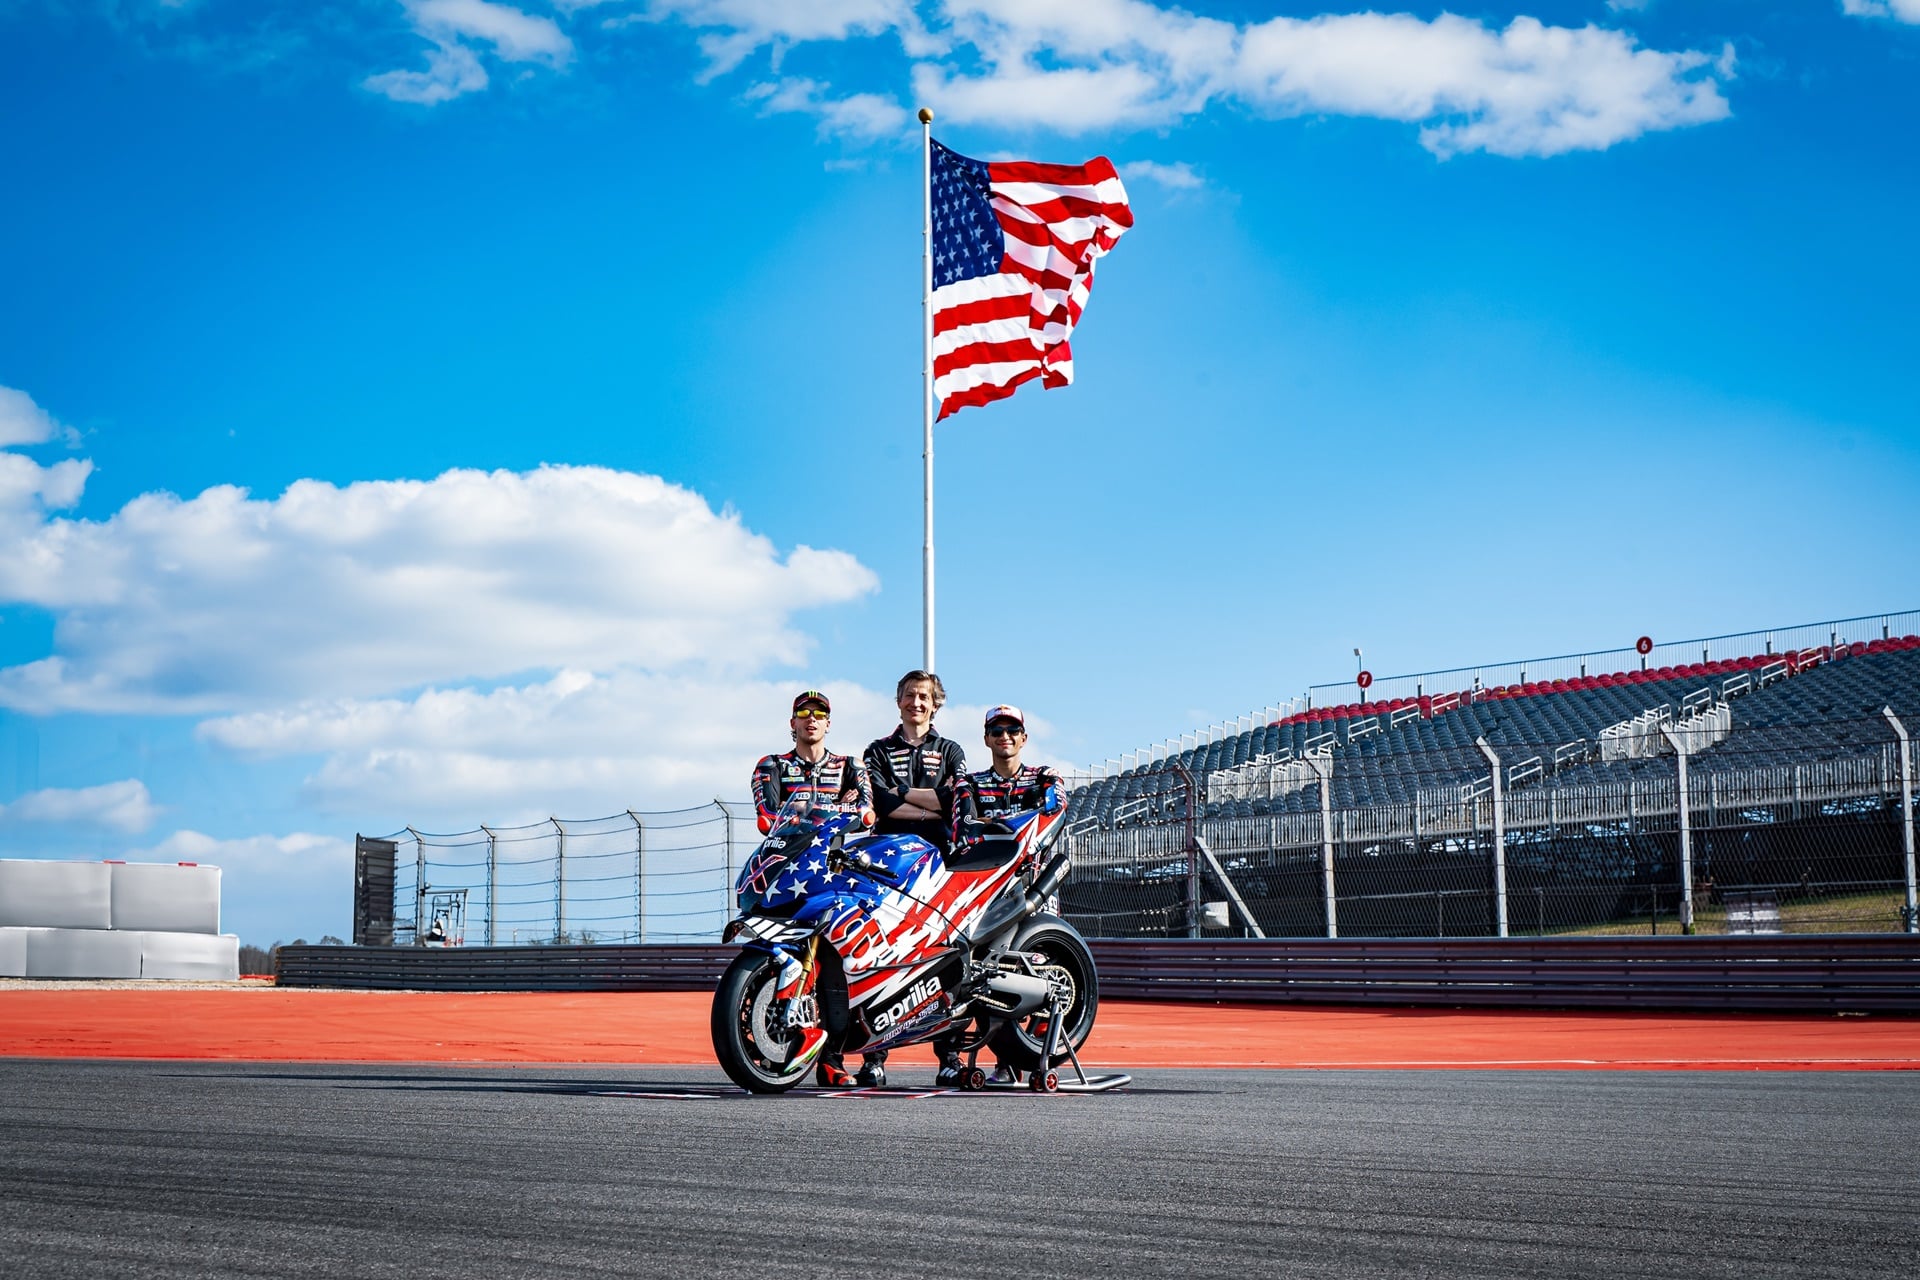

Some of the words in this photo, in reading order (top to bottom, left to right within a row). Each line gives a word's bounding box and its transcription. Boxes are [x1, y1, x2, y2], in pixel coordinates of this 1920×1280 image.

[1641, 640, 1648, 650] 6
[1361, 674, 1369, 685] 7
[821, 802, 857, 813] aprilia
[873, 976, 942, 1032] aprilia
